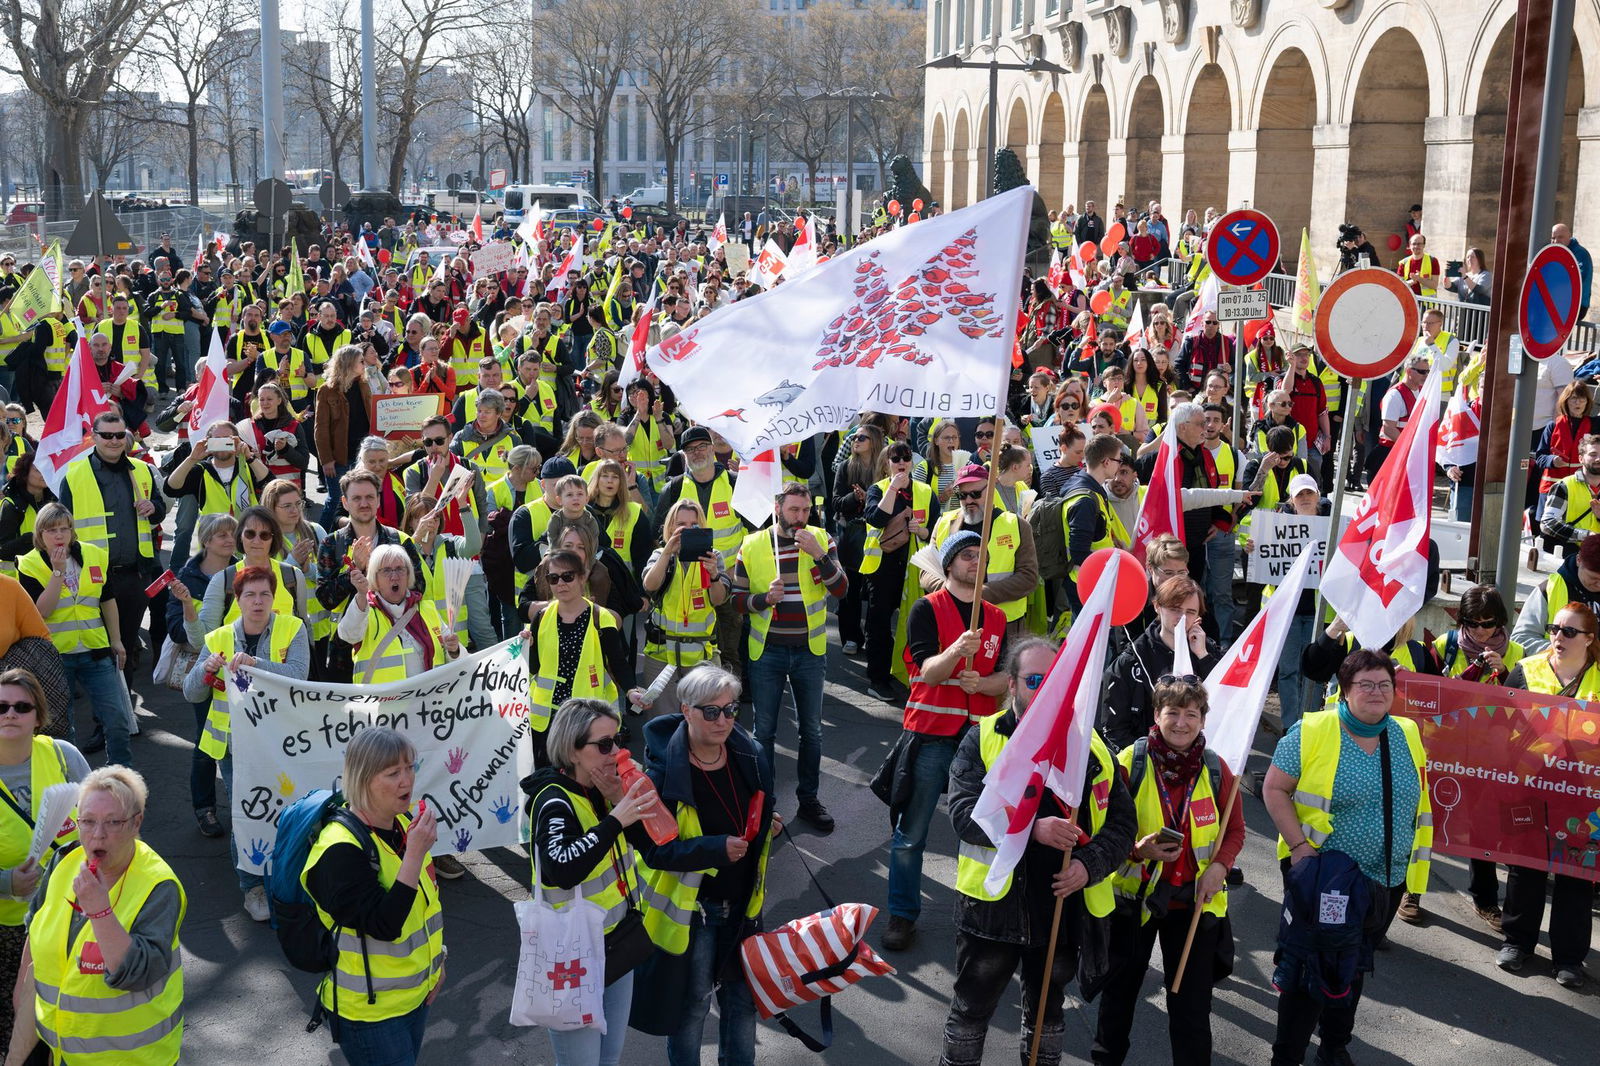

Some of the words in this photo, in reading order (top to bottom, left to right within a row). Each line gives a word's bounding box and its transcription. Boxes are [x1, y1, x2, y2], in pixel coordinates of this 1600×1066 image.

[1258, 293, 1266, 302] 25
[1251, 308, 1262, 317] Uhr
[1043, 448, 1061, 461] SI
[1275, 524, 1310, 540] WIR
[1259, 542, 1302, 559] SIND
[244, 691, 278, 728] Wir
[289, 686, 379, 708] haben
[398, 670, 467, 701] zwei
[1408, 697, 1438, 710] ver.di
[282, 729, 312, 757] es
[416, 694, 493, 741] täglich
[498, 696, 530, 719] vier
[1194, 812, 1216, 822] ver.di
